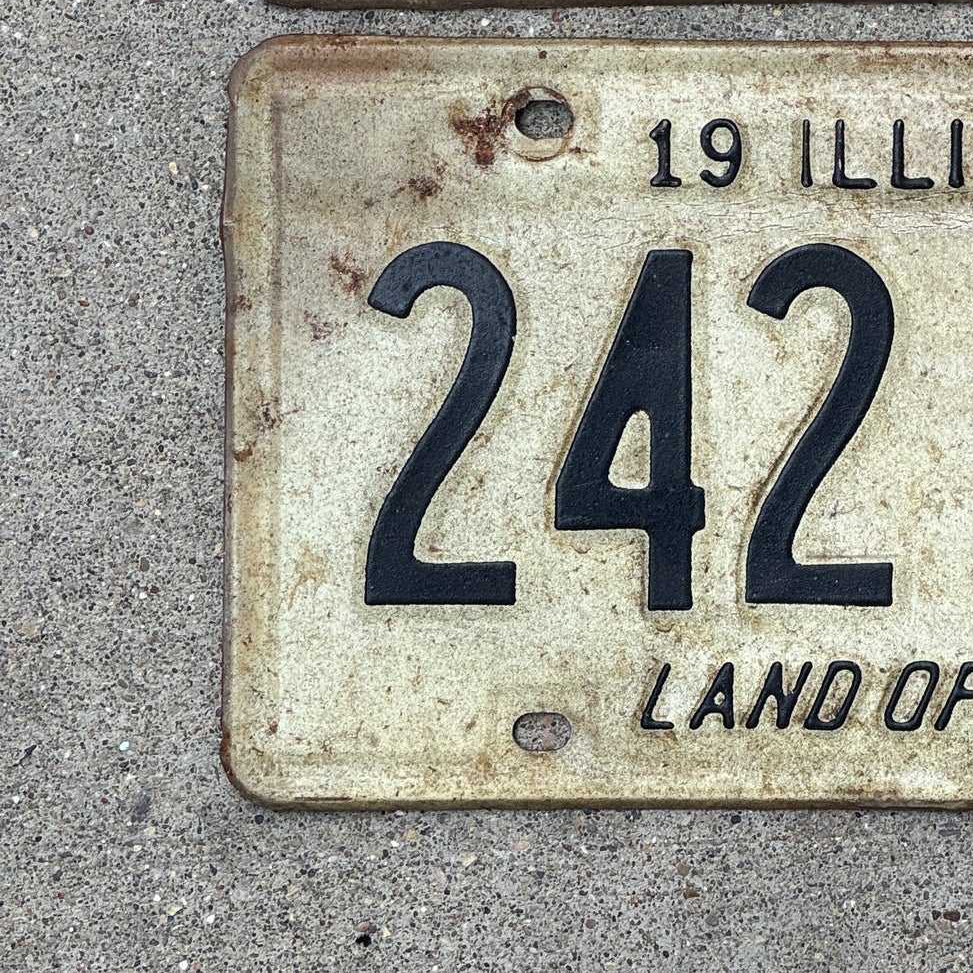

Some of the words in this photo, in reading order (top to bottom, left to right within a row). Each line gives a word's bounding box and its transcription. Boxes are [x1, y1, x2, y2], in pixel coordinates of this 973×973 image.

[648, 118, 744, 190] 19
[363, 240, 896, 613] 242
[638, 660, 864, 733] LAND
